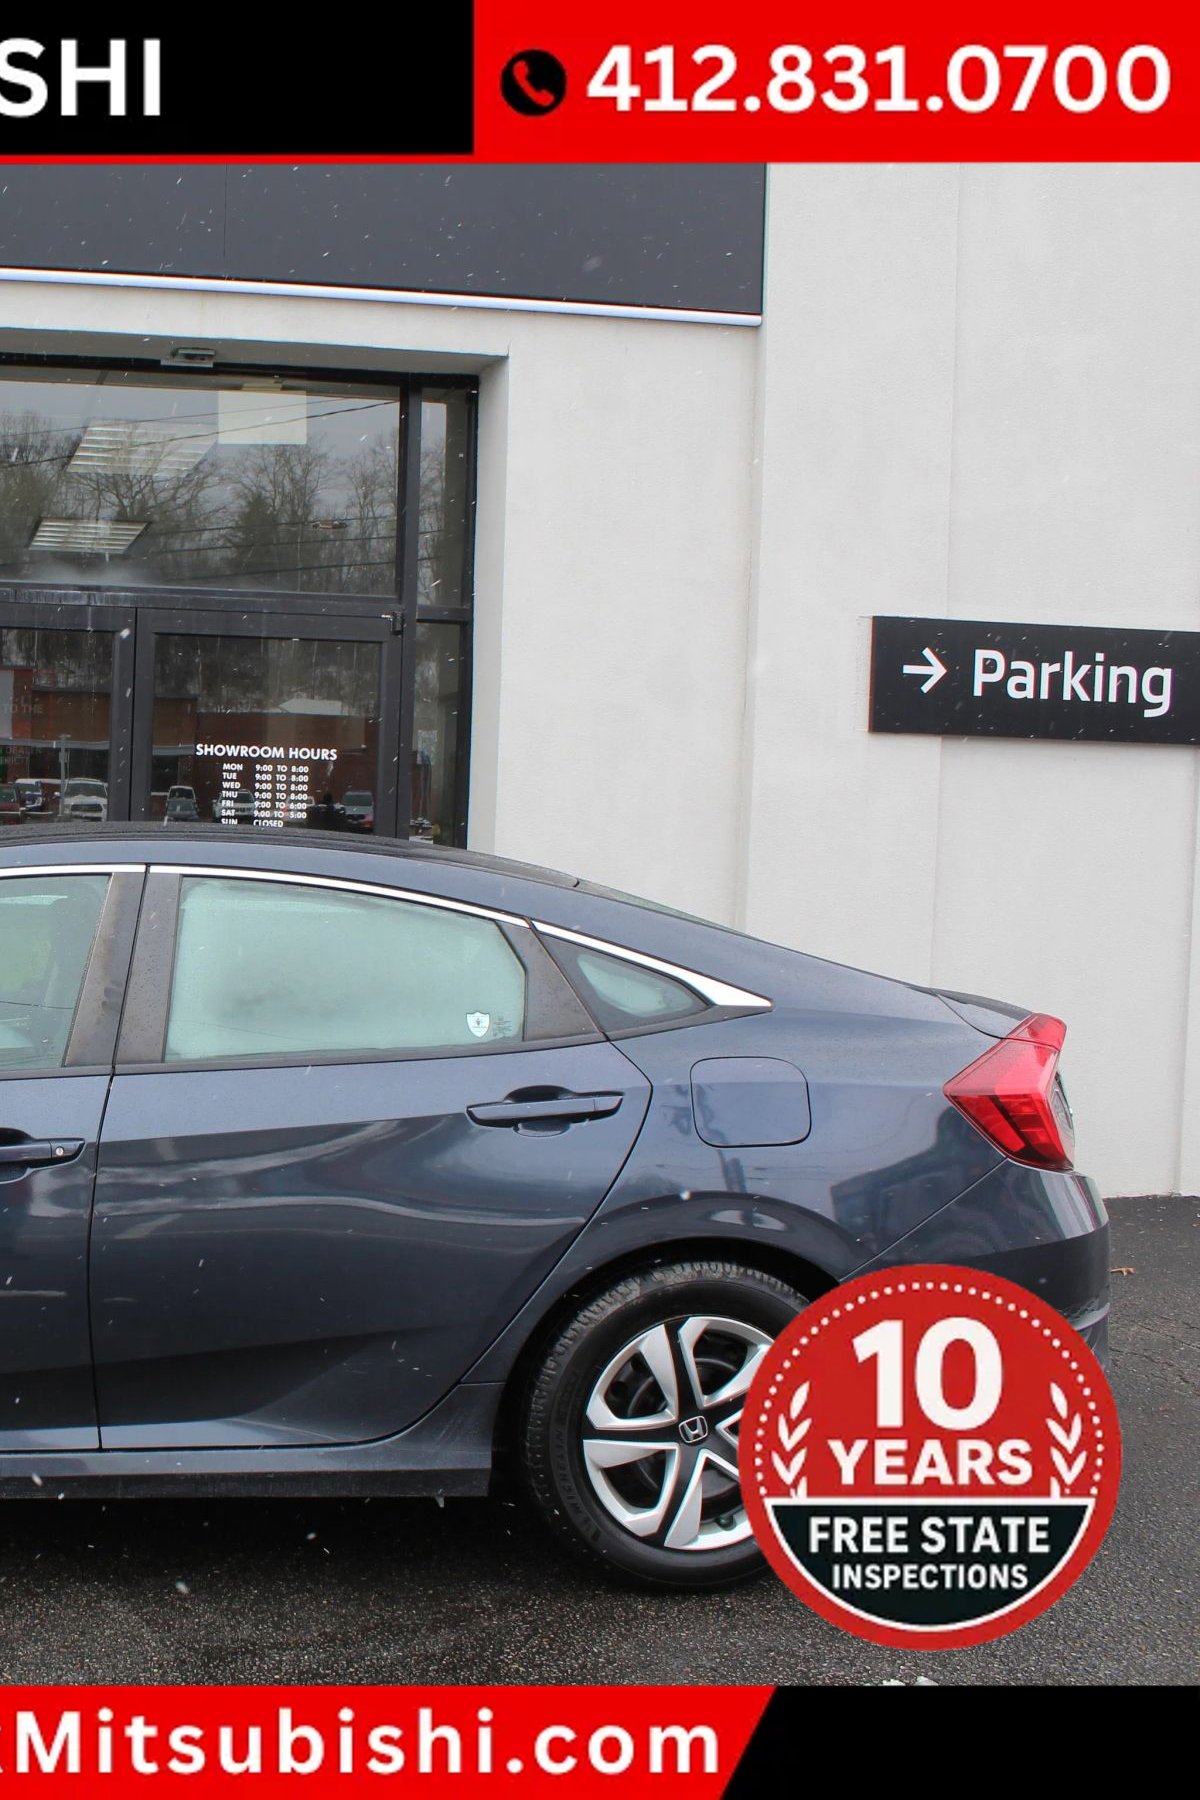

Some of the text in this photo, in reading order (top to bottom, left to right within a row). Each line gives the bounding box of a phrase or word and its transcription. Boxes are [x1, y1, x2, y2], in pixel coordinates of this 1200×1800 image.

[973, 649, 1174, 718] Parking
[195, 743, 338, 761] SHOWROOM HOURS
[223, 763, 243, 771] MON
[277, 765, 287, 773] TO
[222, 772, 237, 780] TUE
[276, 783, 286, 791] TO
[254, 792, 272, 800] 9:00
[290, 793, 308, 801] 8:00
[254, 801, 271, 809] 9:00
[221, 809, 236, 817] SAT
[253, 810, 270, 818] 9:00
[253, 820, 284, 828] CLOSED
